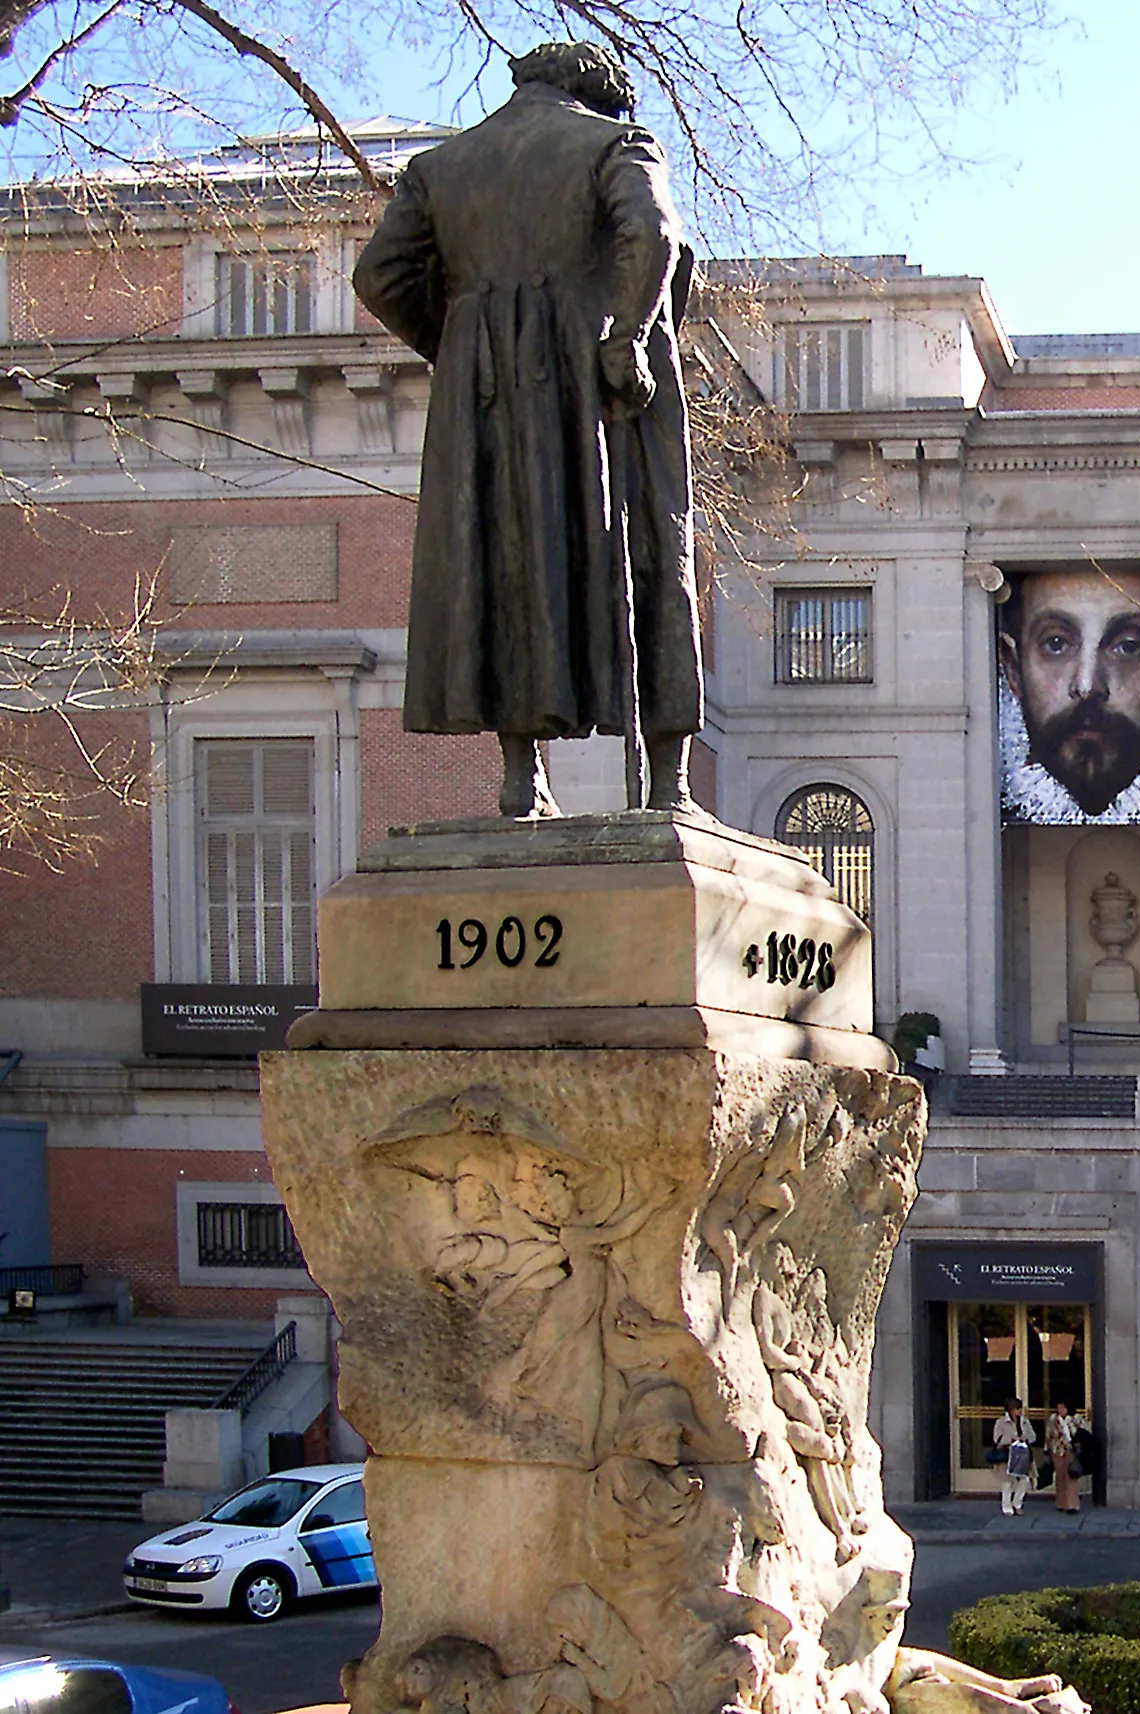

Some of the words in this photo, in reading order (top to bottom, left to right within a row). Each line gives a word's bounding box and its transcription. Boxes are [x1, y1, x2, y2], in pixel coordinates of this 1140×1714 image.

[436, 915, 563, 969] 1902
[163, 1005, 177, 1015] EL
[178, 1005, 229, 1016] RETRATO
[229, 1003, 279, 1016] ESPAÑOL
[992, 1265, 1034, 1274] RETRATO
[1034, 1264, 1074, 1275] ESPAÑOL
